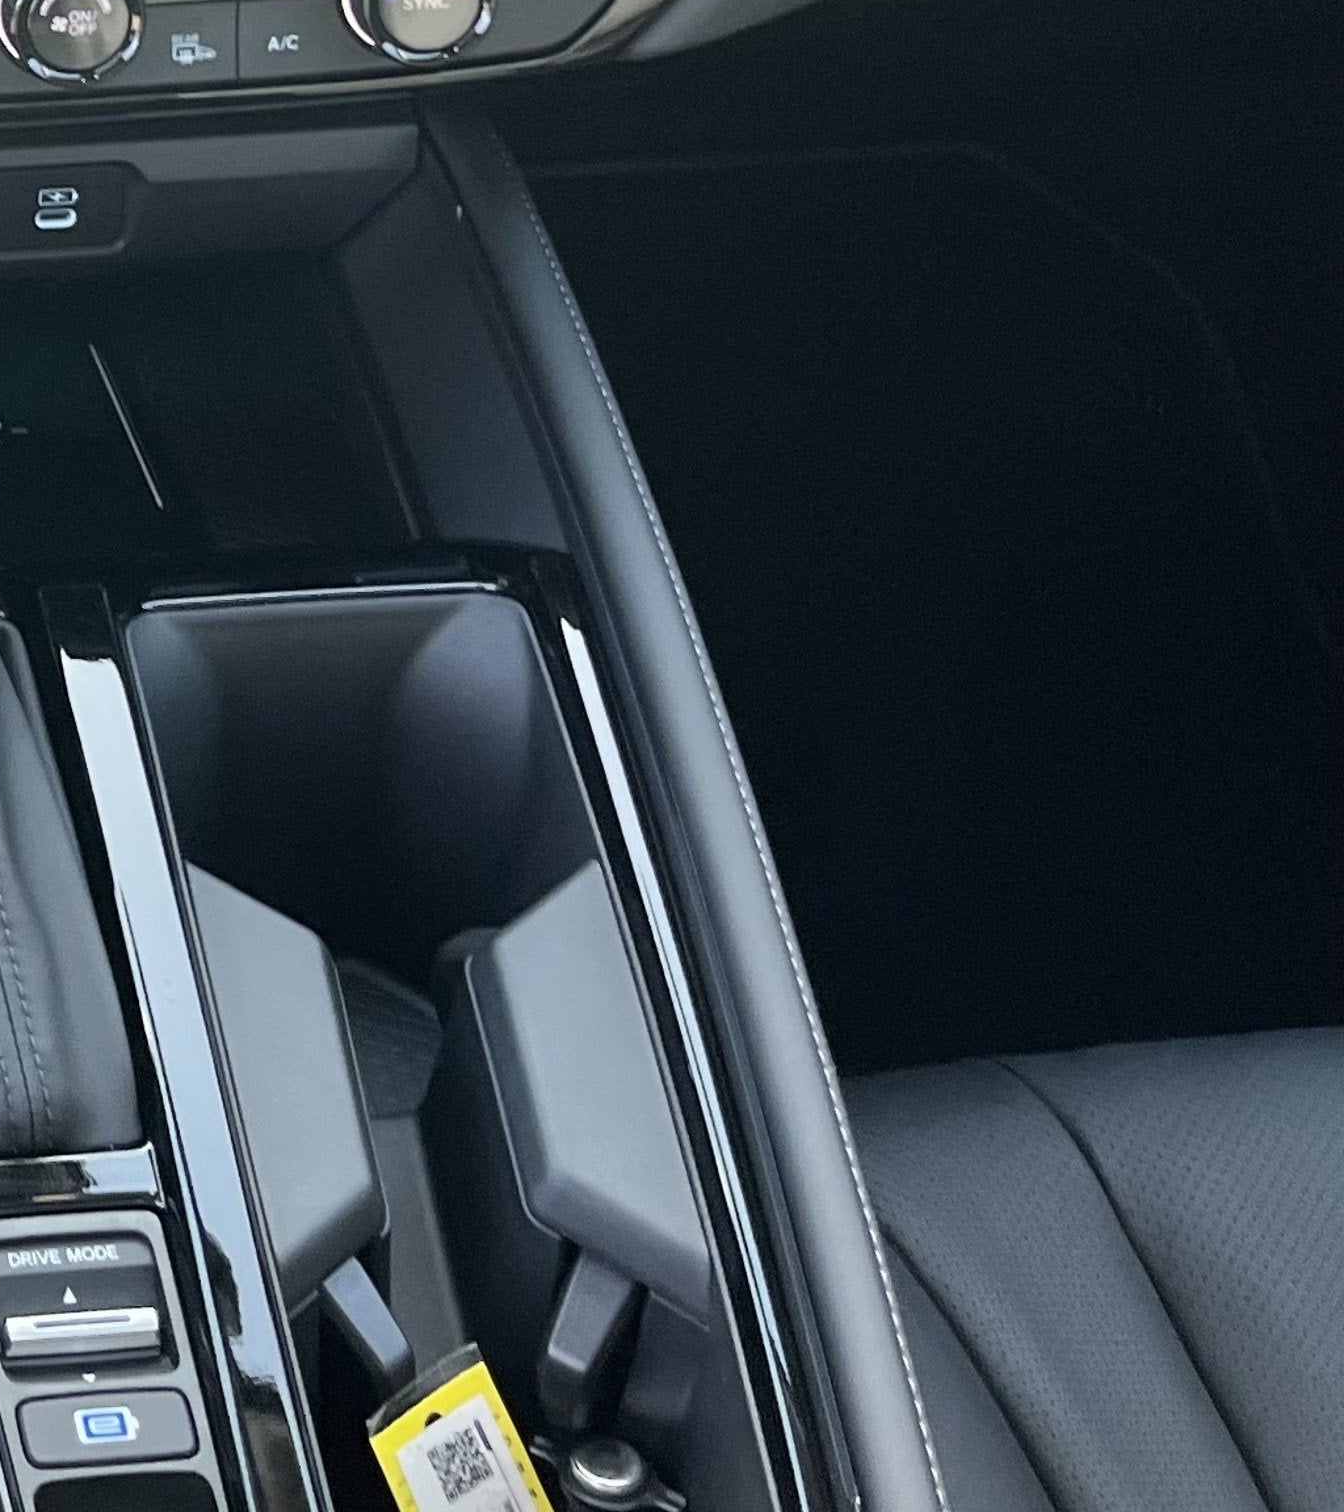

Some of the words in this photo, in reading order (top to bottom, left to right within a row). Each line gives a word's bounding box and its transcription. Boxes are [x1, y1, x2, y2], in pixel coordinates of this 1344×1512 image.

[67, 21, 98, 37] OFF
[267, 34, 299, 52] A/C
[7, 1248, 61, 1269] DRIVE
[66, 1244, 120, 1264] MODE
